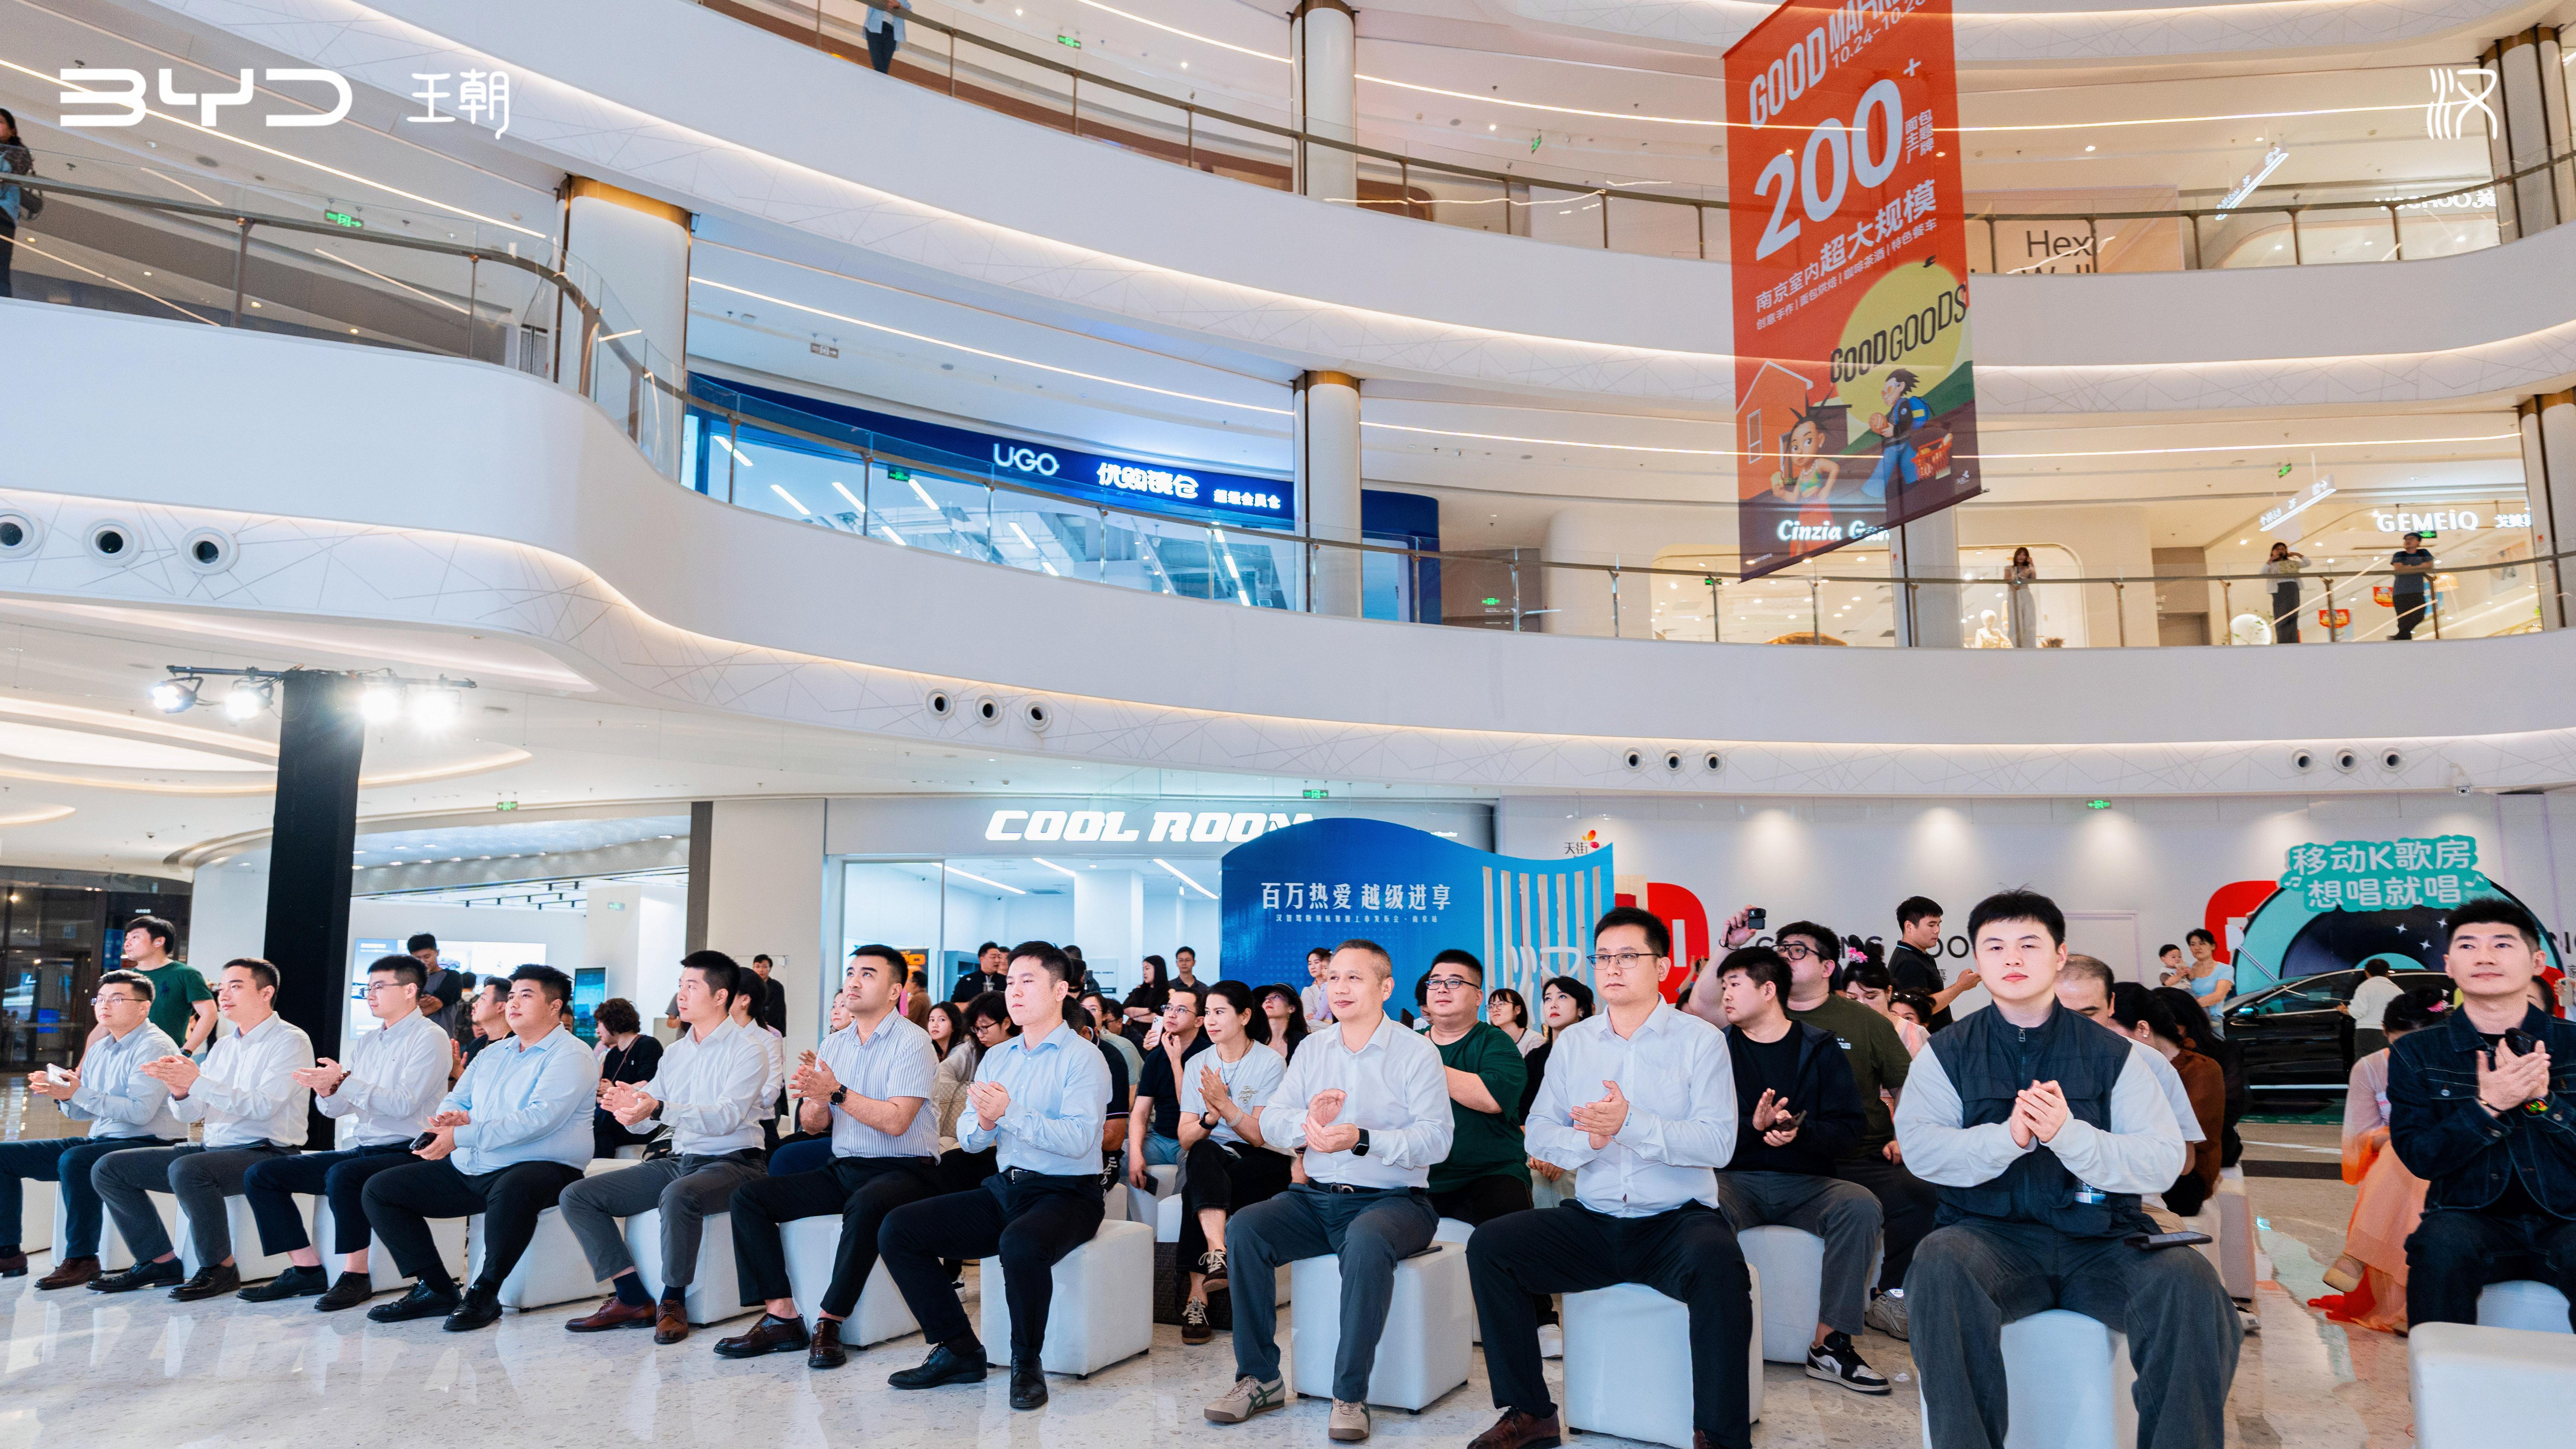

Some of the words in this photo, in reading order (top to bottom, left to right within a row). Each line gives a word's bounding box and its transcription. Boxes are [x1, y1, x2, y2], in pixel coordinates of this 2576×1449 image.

[1750, 27, 1826, 129] GOOD
[1756, 179, 1937, 313] 南京室内超大规模
[2026, 230, 2092, 257] Hex
[1756, 301, 1794, 330] 创意手作
[1891, 218, 1937, 252] 特色餐车
[1830, 330, 1887, 384] GOOD
[1889, 283, 1967, 362] GOODS
[993, 443, 1060, 476] UGO
[1777, 519, 1843, 541] Cinzia
[985, 810, 1140, 842] COOL
[1564, 842, 1588, 854] 天街
[2292, 839, 2472, 875] 移动K歌房
[1261, 882, 1352, 910] 百万热爱
[1361, 883, 1451, 910] 越级进享
[2307, 874, 2462, 908] 想唱就唱
